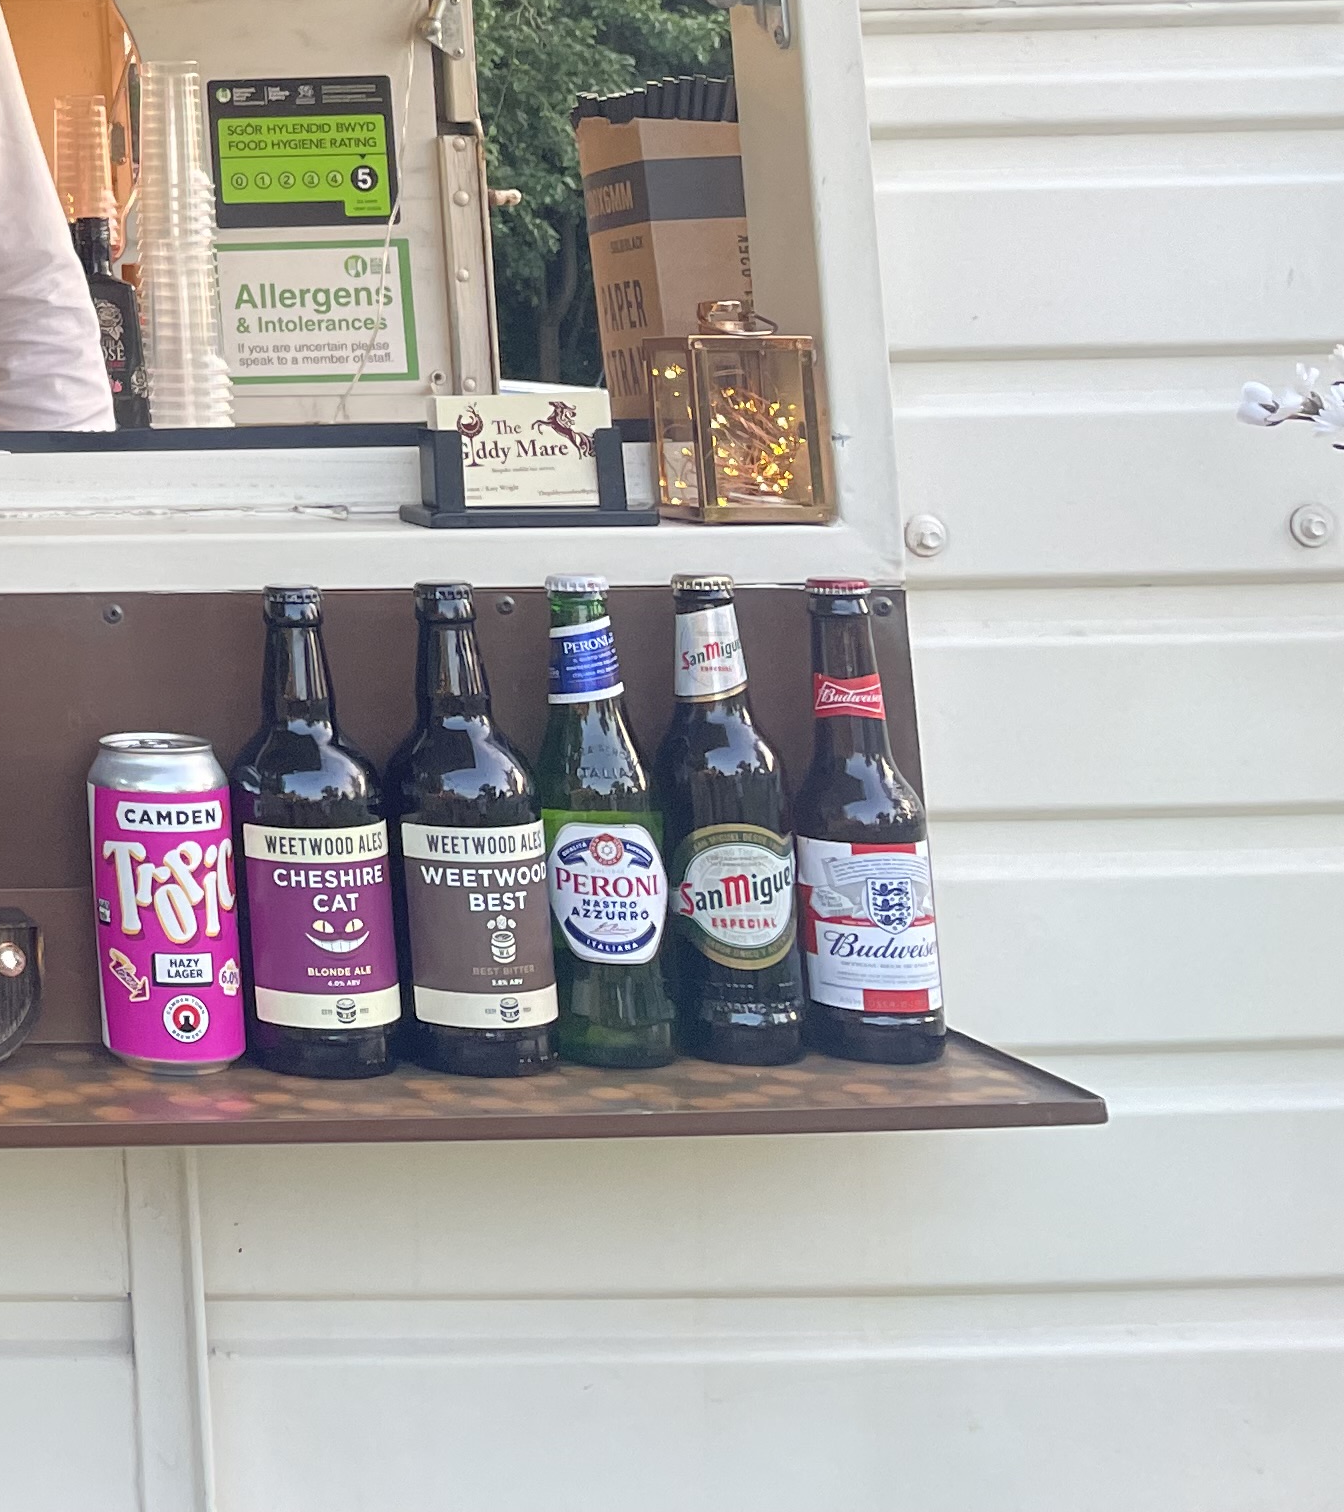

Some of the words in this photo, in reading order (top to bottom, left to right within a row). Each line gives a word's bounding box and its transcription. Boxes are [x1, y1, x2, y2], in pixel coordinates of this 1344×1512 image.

[227, 122, 263, 136] SGÔR
[267, 123, 331, 135] HYLENDID
[336, 122, 376, 133] BWYD
[228, 140, 268, 151] FOOD
[271, 138, 327, 150] HYGIENE
[330, 137, 377, 148] RATING
[283, 175, 291, 186] 2
[307, 175, 315, 185] 3
[330, 174, 338, 184] 4
[357, 168, 372, 190] 5
[235, 283, 393, 314] Allergens
[602, 279, 648, 334] PAPER
[236, 317, 251, 334] &
[258, 316, 388, 333] Intolerances
[238, 343, 245, 353] If
[248, 344, 269, 356] you
[272, 344, 291, 353] are
[294, 342, 348, 352] uncertain
[351, 341, 390, 353] please
[239, 356, 275, 368] speak
[277, 356, 288, 365] to
[291, 356, 299, 365] a
[302, 354, 350, 365] member
[352, 353, 365, 363] of
[491, 420, 522, 435] The
[516, 439, 569, 458] Mare
[563, 634, 609, 654] PERONI
[681, 650, 706, 671] San
[123, 807, 217, 826] CAMDEN
[265, 834, 354, 856] WEETWOOD
[358, 831, 383, 853] ALES
[426, 833, 516, 855] WEETWOOD
[520, 830, 542, 852] ALES
[273, 864, 384, 888] CHESHIRE
[420, 861, 547, 887] WEETWOOD
[555, 867, 660, 898] PERONI
[679, 883, 724, 916] San
[720, 866, 794, 906] Migue
[312, 892, 360, 912] CAT
[468, 891, 527, 912] BEST
[582, 898, 637, 909] NASTRO
[571, 906, 650, 921] AZZURRO
[712, 917, 777, 930] ESPECIAL
[586, 939, 639, 952] ITALIANA
[169, 958, 200, 969] HAZY
[307, 967, 351, 977] BLONDE
[354, 965, 372, 976] ALE
[472, 967, 499, 976] BEST
[502, 964, 535, 976] BITTER
[167, 969, 203, 979] LAGER
